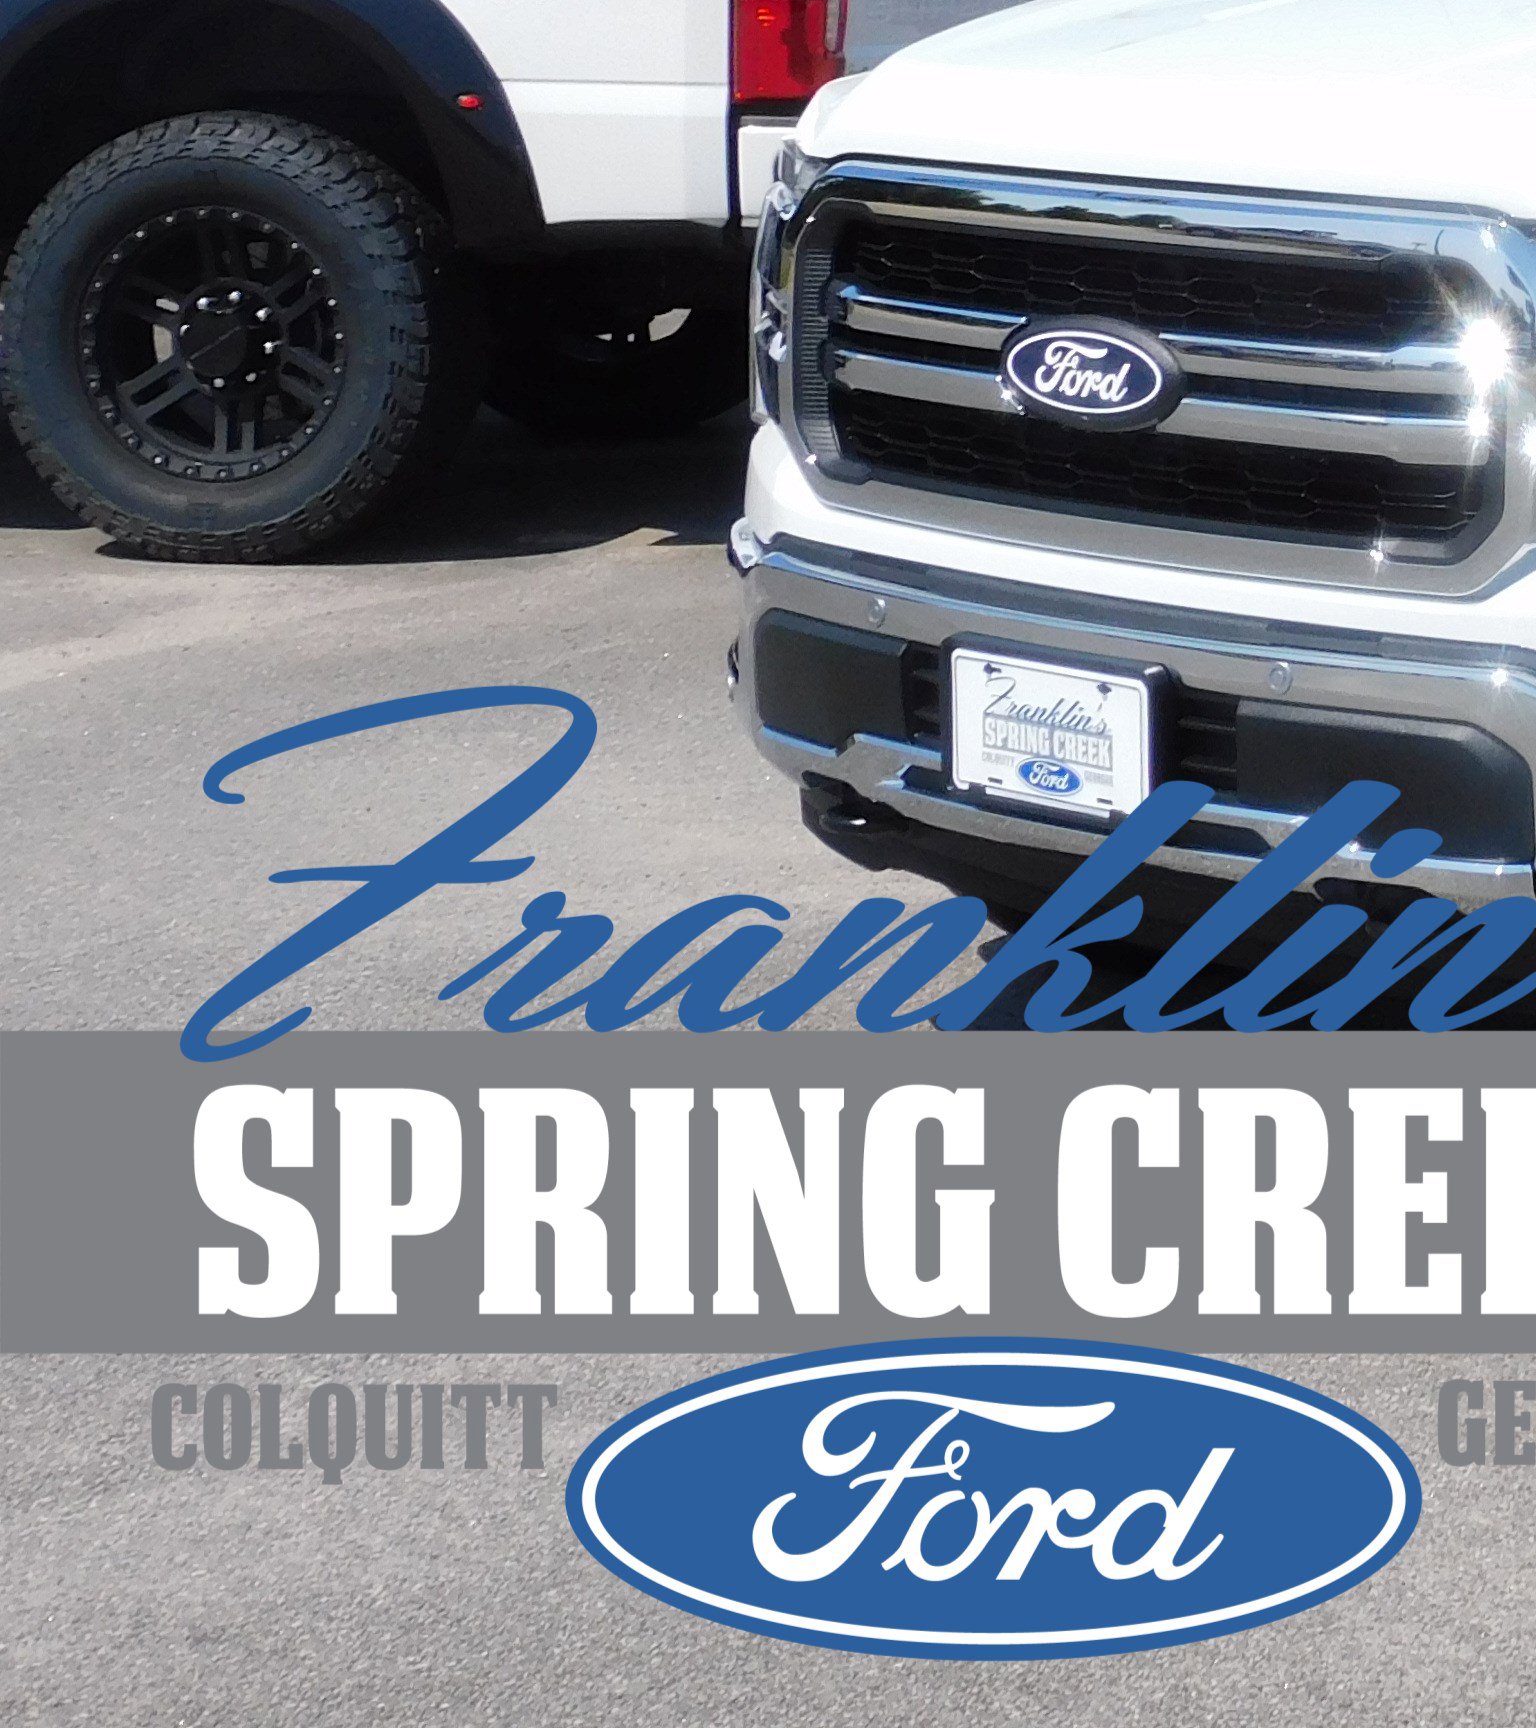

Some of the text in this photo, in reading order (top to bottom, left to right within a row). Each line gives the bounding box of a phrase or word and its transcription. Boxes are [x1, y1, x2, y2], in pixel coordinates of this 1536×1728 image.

[1034, 340, 1131, 402] Ford
[984, 676, 1111, 735] Franklin's
[983, 717, 1112, 769] SPRING CREEK
[1028, 761, 1070, 790] Ford
